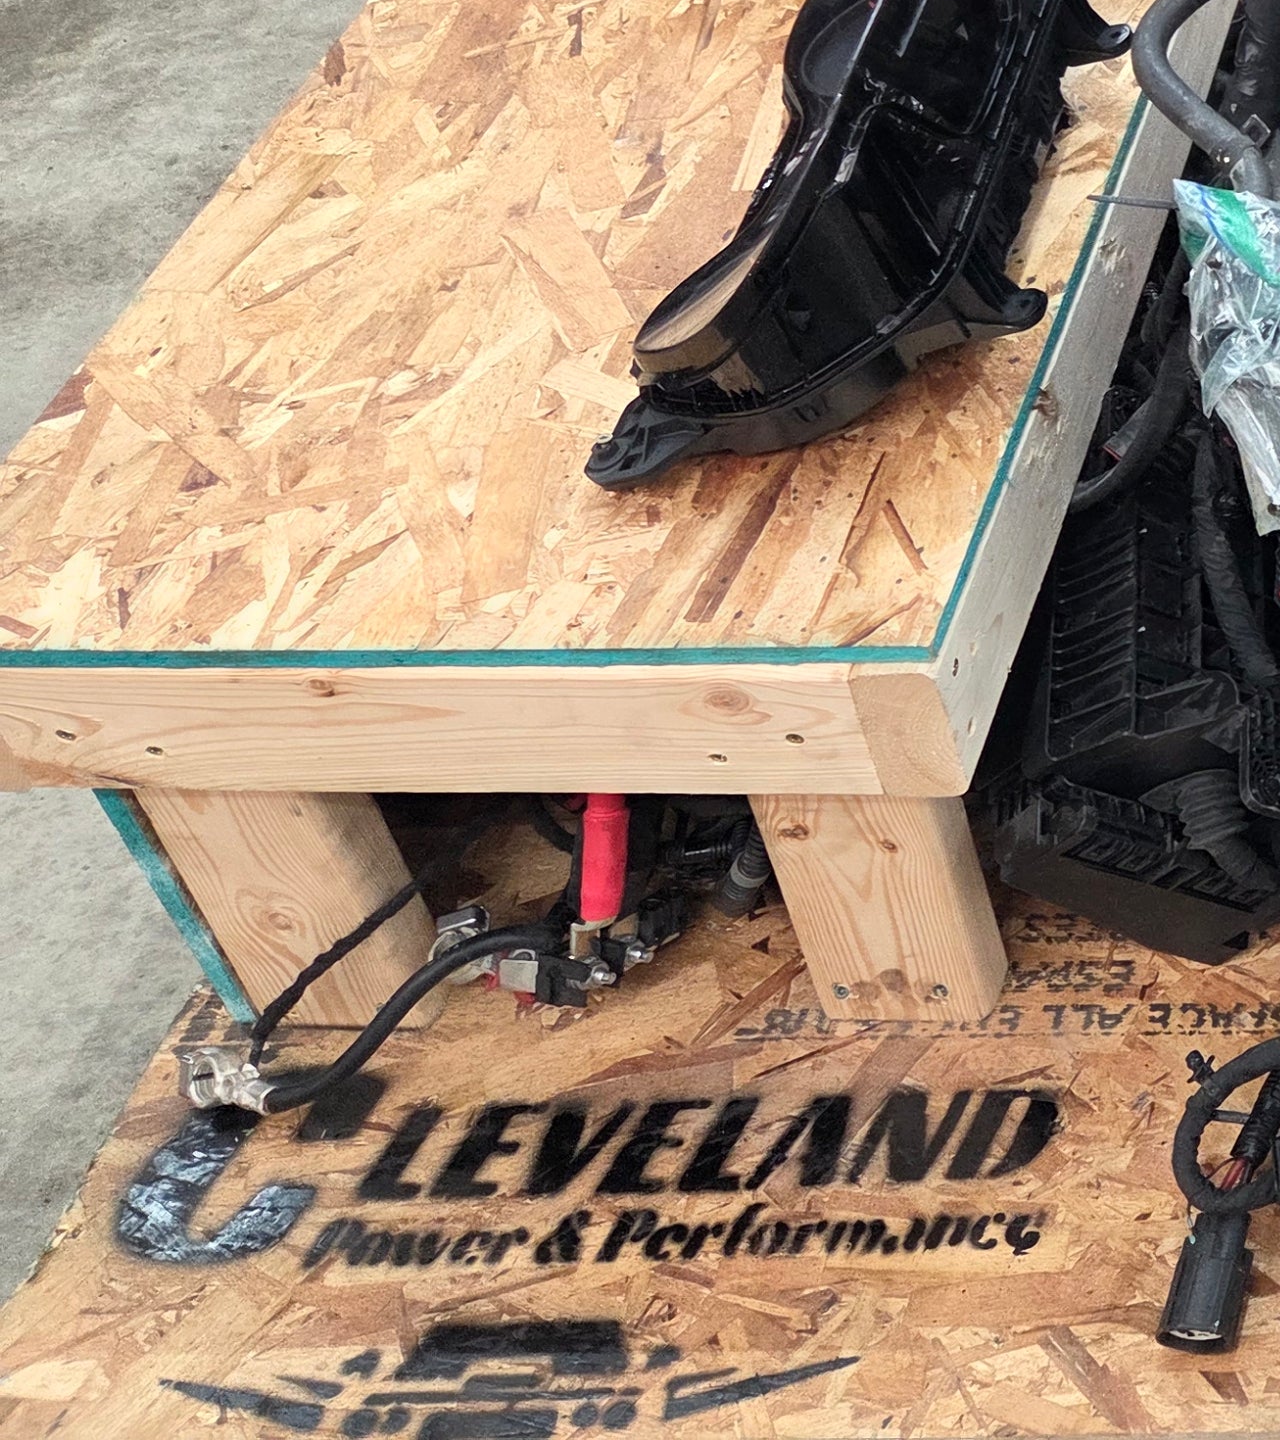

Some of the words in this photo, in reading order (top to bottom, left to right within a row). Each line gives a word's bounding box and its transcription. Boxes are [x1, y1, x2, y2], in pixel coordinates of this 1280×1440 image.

[113, 1057, 1064, 1270] CLEVELAND
[300, 1212, 532, 1270] Power
[534, 1207, 592, 1264] &
[595, 1201, 1052, 1264] Performance
